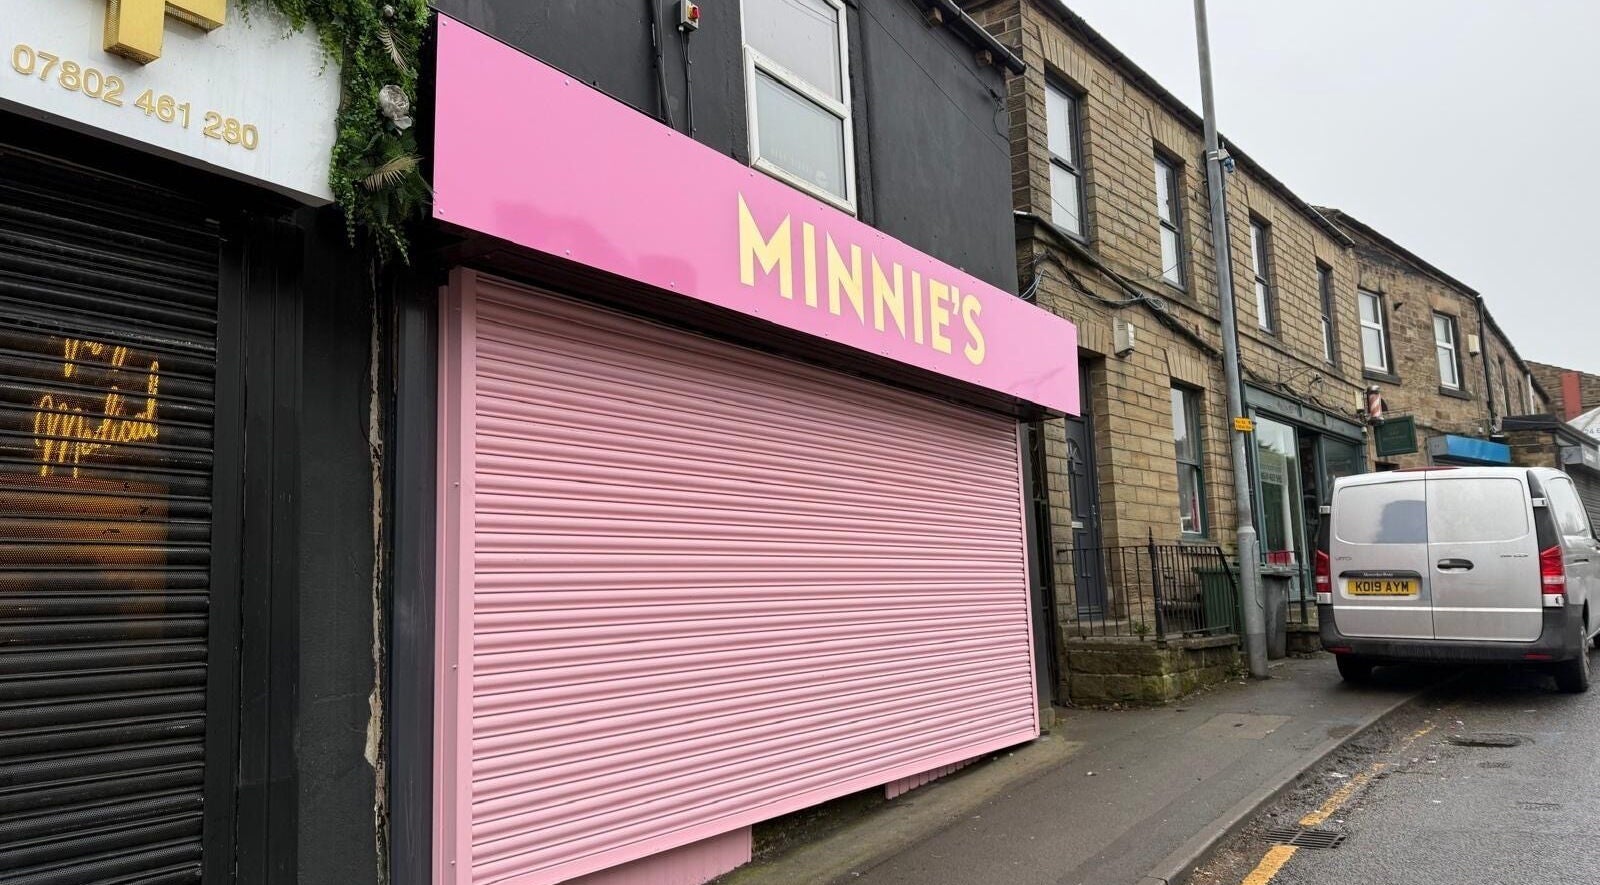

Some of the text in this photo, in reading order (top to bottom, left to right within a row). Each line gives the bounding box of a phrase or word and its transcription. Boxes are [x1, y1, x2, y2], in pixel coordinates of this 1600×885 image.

[11, 44, 259, 150] 07802 461 280
[738, 191, 986, 366] MINNIE'S
[1355, 581, 1409, 592] KO19 AYM
